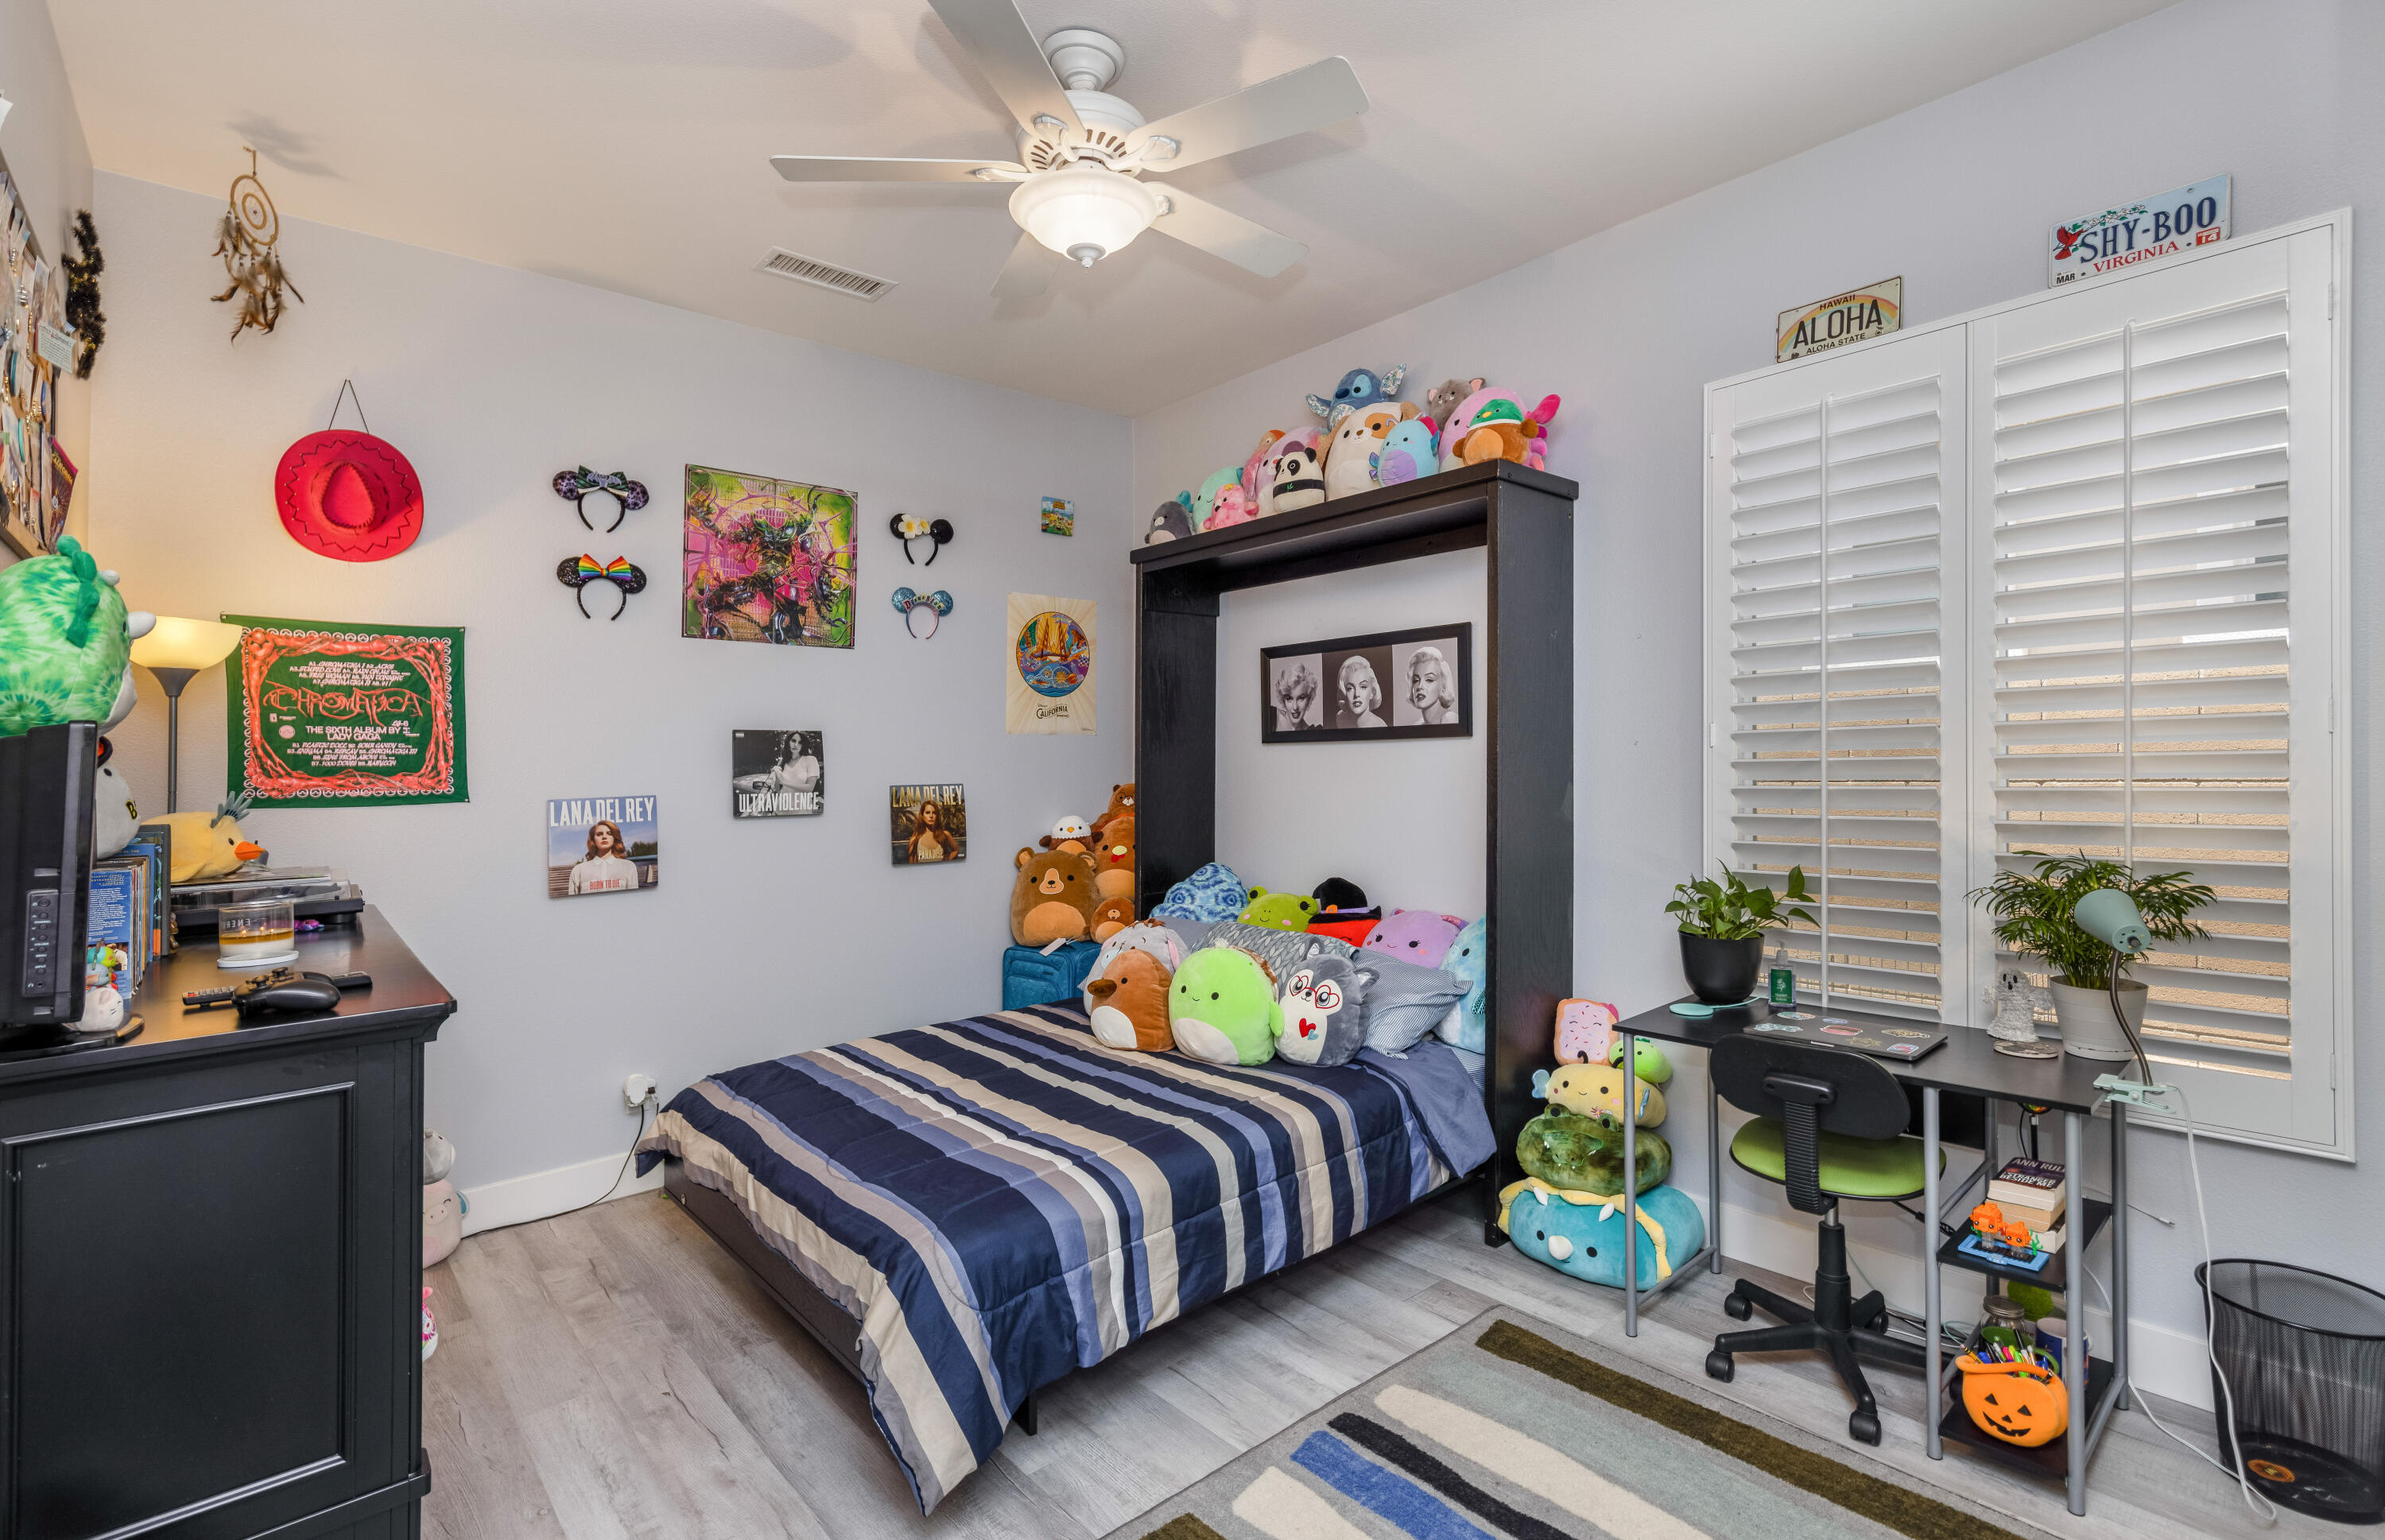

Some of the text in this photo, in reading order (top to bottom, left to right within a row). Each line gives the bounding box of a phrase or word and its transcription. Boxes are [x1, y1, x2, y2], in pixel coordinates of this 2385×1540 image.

[2081, 196, 2216, 264] SHY-BOO
[2201, 233, 2216, 244] 14
[2093, 241, 2181, 273] VIRGINIA
[2057, 273, 2075, 285] MAR
[1819, 294, 1856, 311] HAWAII
[1793, 299, 1883, 350] ALOHA
[1806, 333, 1866, 355] ALOHA STATE
[1037, 705, 1068, 719] CALIFORNIA
[739, 792, 820, 813] ULTRAVIOLENCE
[892, 786, 963, 808] LANA DEL REY
[550, 797, 655, 828] LANA DEL REY
[918, 848, 944, 860] PARADISE
[589, 879, 621, 890] BORN TO DIE
[2011, 1158, 2038, 1168] ANN
[1999, 1173, 2034, 1185] BESIDE
[2007, 1173, 2057, 1185] STRANGER
